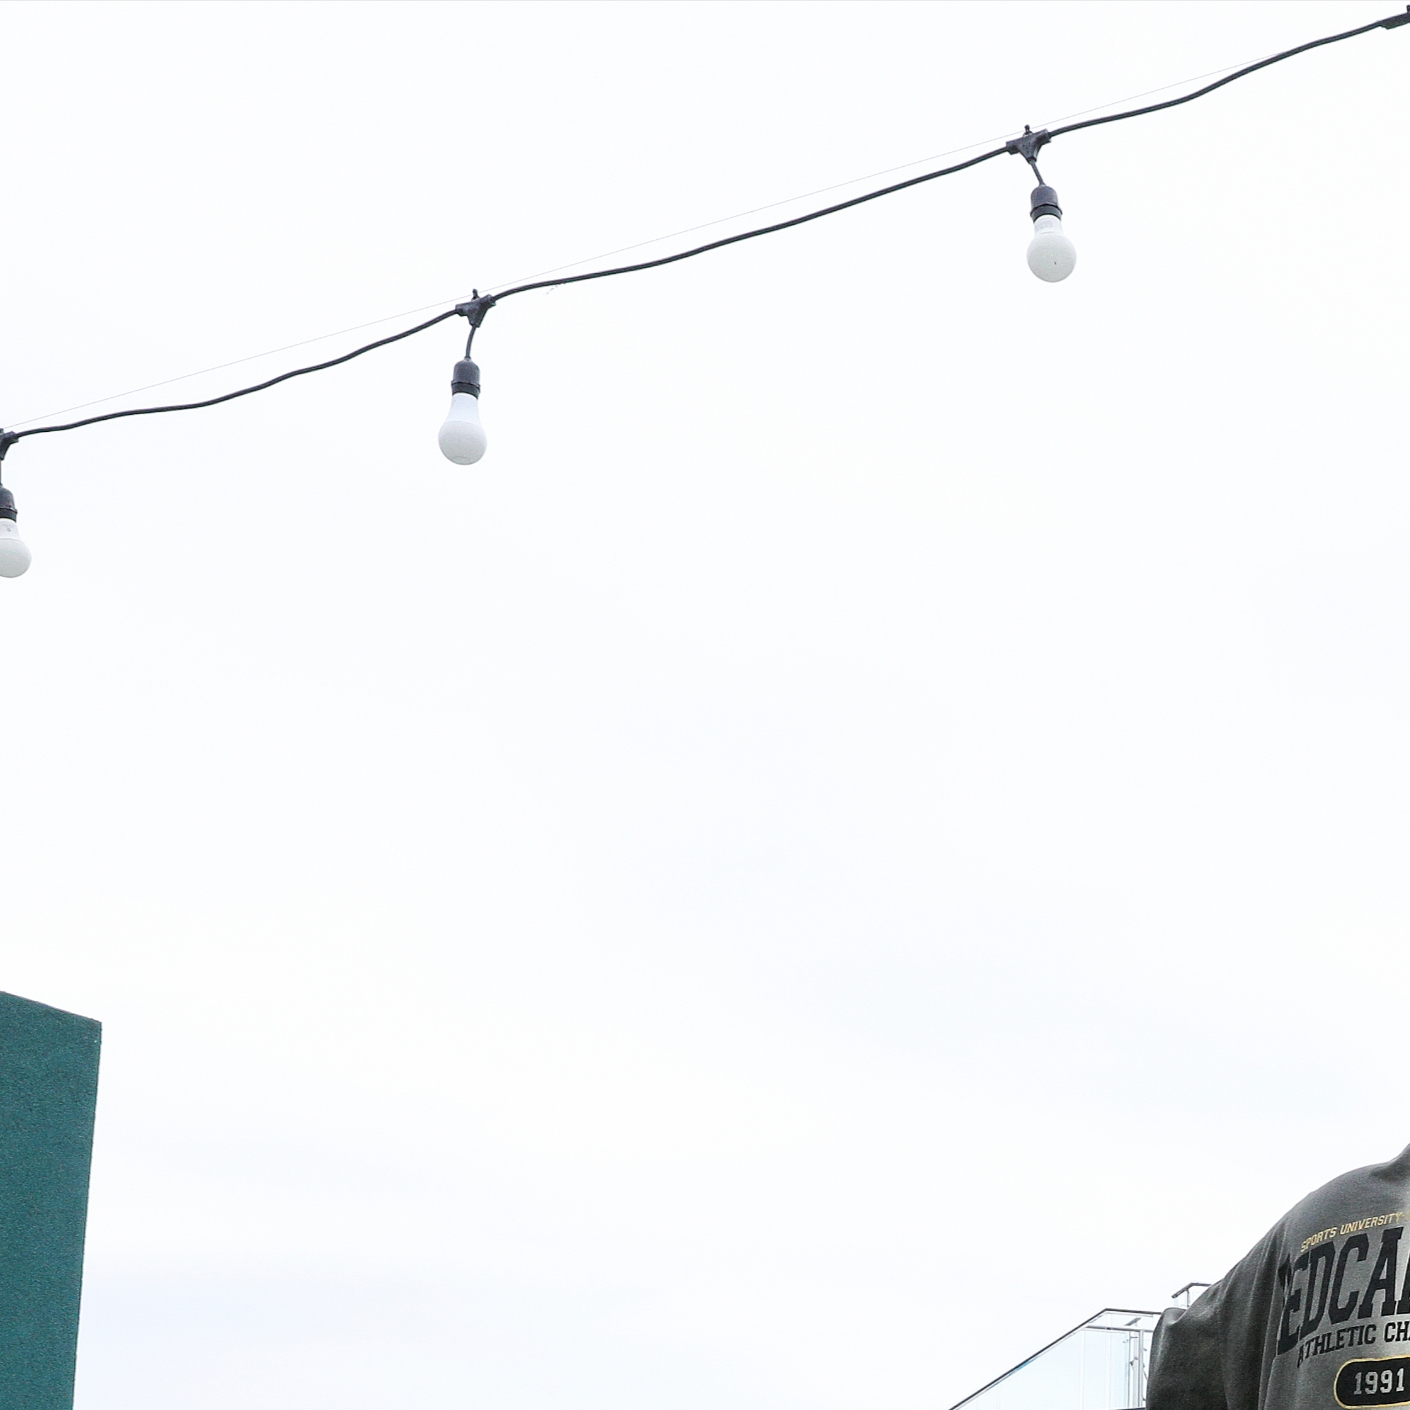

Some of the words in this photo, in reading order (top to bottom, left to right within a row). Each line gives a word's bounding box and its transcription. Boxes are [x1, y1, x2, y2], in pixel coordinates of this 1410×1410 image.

[1300, 1226, 1338, 1252] SPORTS
[1340, 1212, 1403, 1235] UNIVERSITY
[1353, 1367, 1405, 1395] 1991
